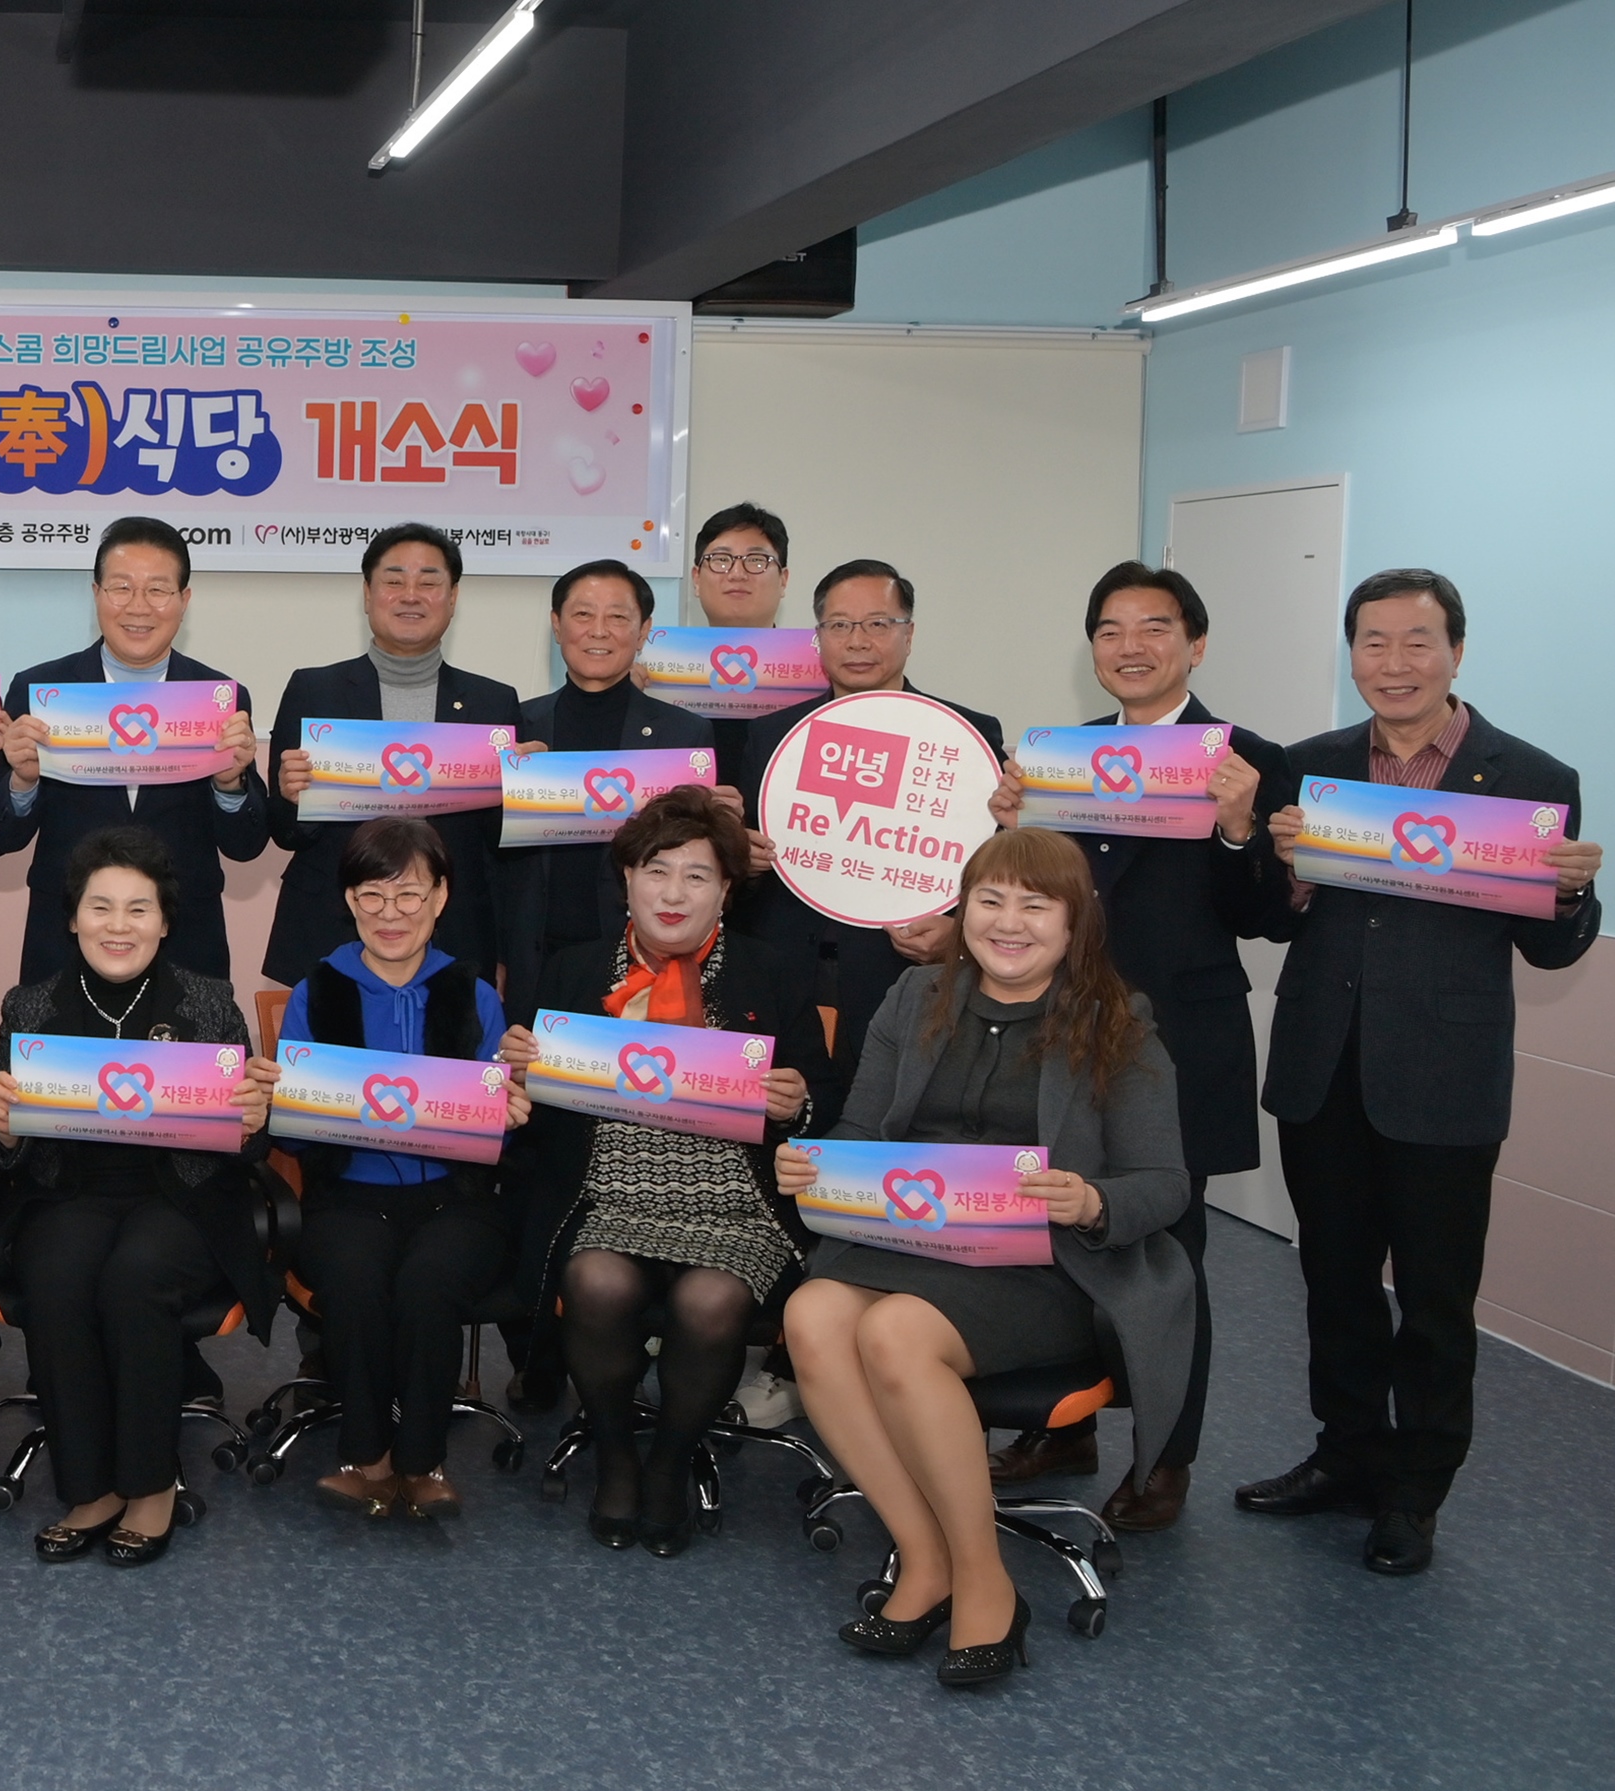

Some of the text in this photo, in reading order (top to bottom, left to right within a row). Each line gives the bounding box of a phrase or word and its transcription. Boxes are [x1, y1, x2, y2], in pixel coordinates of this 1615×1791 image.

[53, 335, 225, 366] 희망드림사업
[237, 337, 351, 368] 공유주방
[361, 339, 416, 368] 조성
[306, 401, 518, 485] 개소식
[21, 523, 90, 543] 공유주방
[668, 663, 685, 673] 잇는
[688, 663, 704, 673] 우리
[63, 725, 82, 736] 잇는
[85, 725, 103, 735] 우리
[165, 721, 225, 736] 자원봉사
[820, 742, 890, 788] 안녕
[918, 741, 960, 766] 안부
[308, 761, 330, 771] 상을
[335, 762, 353, 772] 잇는
[356, 763, 375, 773] 우리
[912, 765, 955, 791] 안전
[1047, 766, 1064, 779] 잇는
[1068, 767, 1085, 779] 우리
[1149, 767, 1215, 785] 자원봉사
[506, 789, 534, 799] 세상을
[538, 789, 556, 799] 잇는
[560, 789, 578, 799] 우리
[906, 792, 949, 818] 안심
[787, 802, 830, 837] Re
[1336, 828, 1358, 842] 잇는
[1362, 830, 1384, 844] 우리
[1462, 841, 1550, 867] 자원봉사
[781, 846, 953, 897] 세상을 잇는 자원봉사
[566, 1056, 586, 1070] 잇는
[589, 1060, 610, 1074] 우리
[47, 1083, 68, 1095] 잇는
[71, 1085, 91, 1096] 우리
[277, 1086, 503, 1125] 세상을 잇는 우리 자원봉사자
[832, 1188, 853, 1201] 잇는
[856, 1191, 877, 1204] 우리
